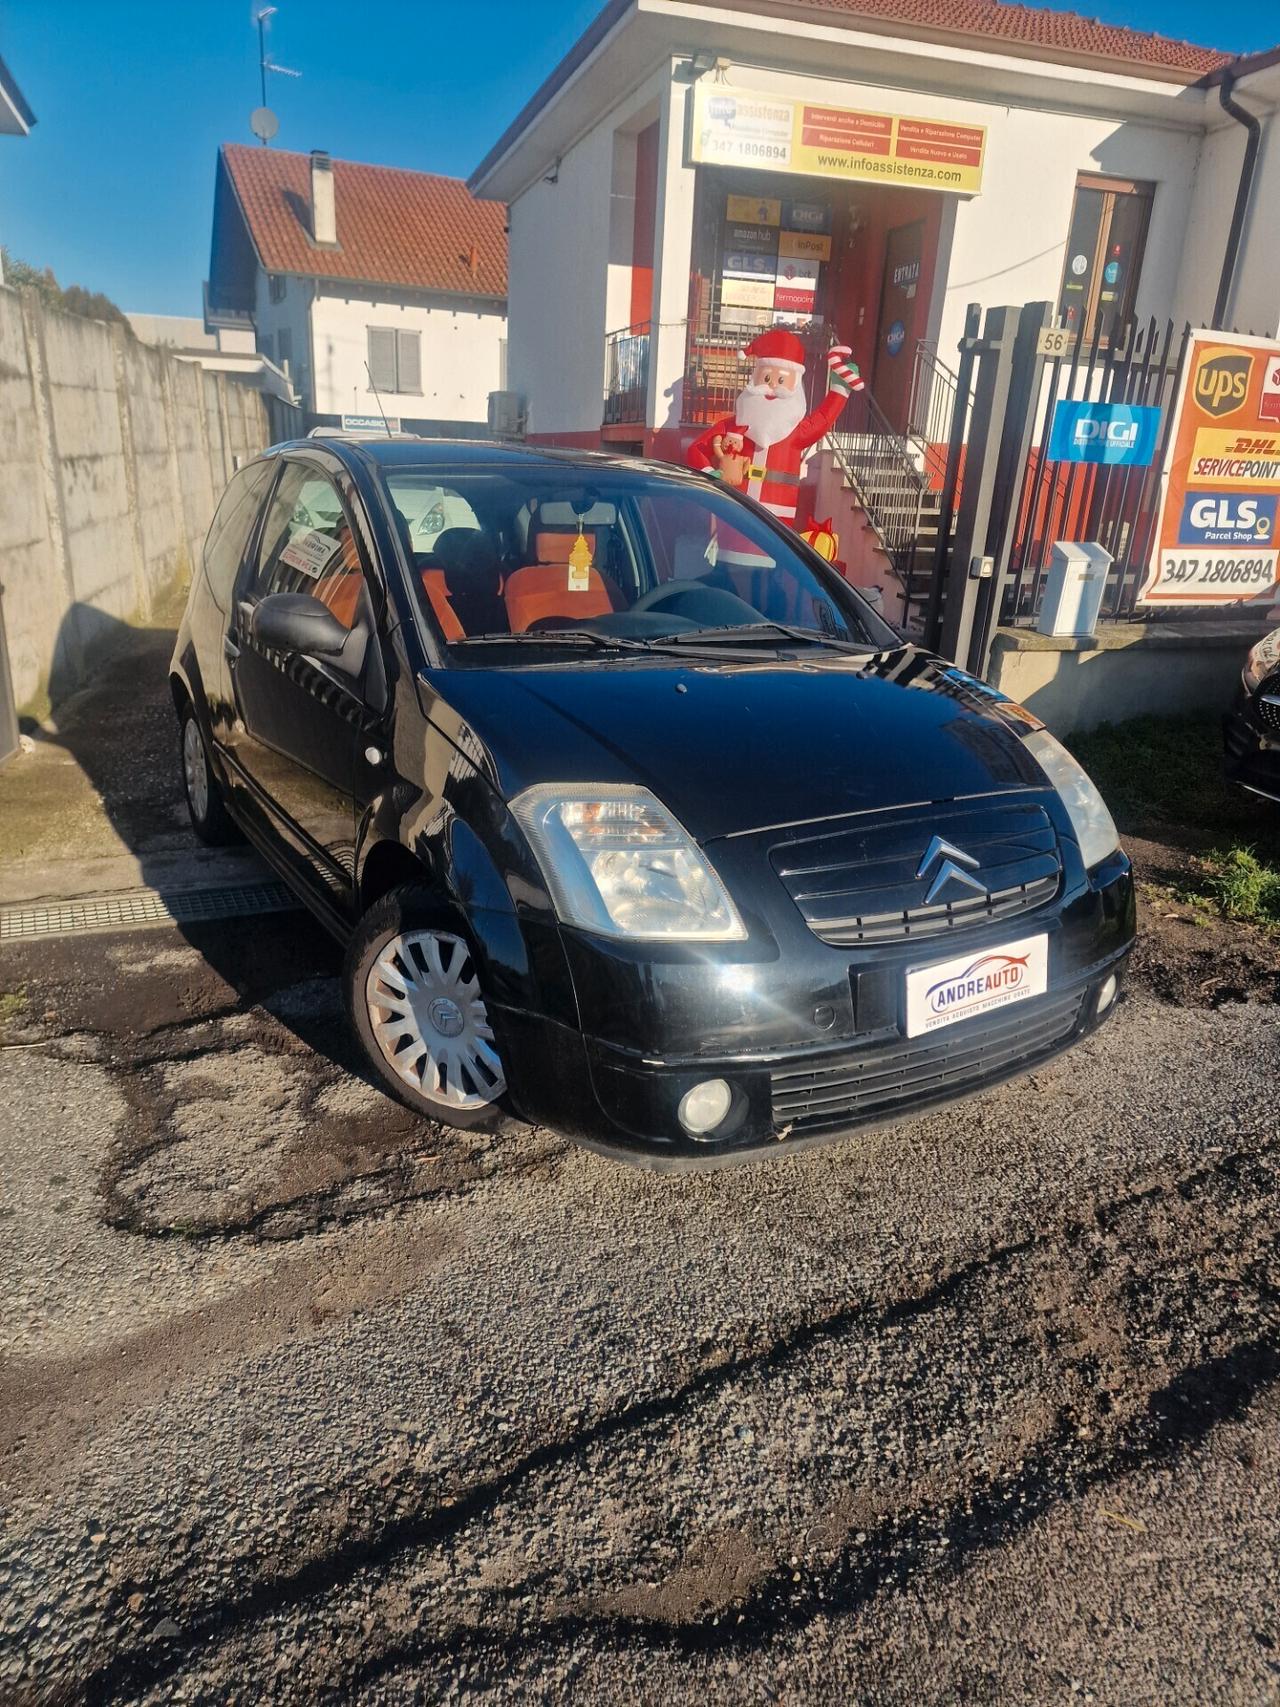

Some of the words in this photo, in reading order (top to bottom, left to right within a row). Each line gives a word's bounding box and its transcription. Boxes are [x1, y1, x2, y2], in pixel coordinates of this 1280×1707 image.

[738, 142, 787, 160] 1806894
[817, 154, 961, 182] www.infoassistenza.com
[758, 230, 771, 241] hub
[727, 255, 766, 271] GLS
[1044, 334, 1063, 350] 56
[1199, 368, 1246, 406] ups
[1075, 419, 1138, 441] DIGI
[1234, 438, 1276, 454] DHL
[1190, 499, 1258, 529] GLS
[1205, 531, 1231, 540] Parcel
[1233, 532, 1252, 542] Shop
[1162, 559, 1198, 583] 347
[1199, 560, 1273, 583] 1806894
[937, 966, 1019, 1008] ANDREAUTO
